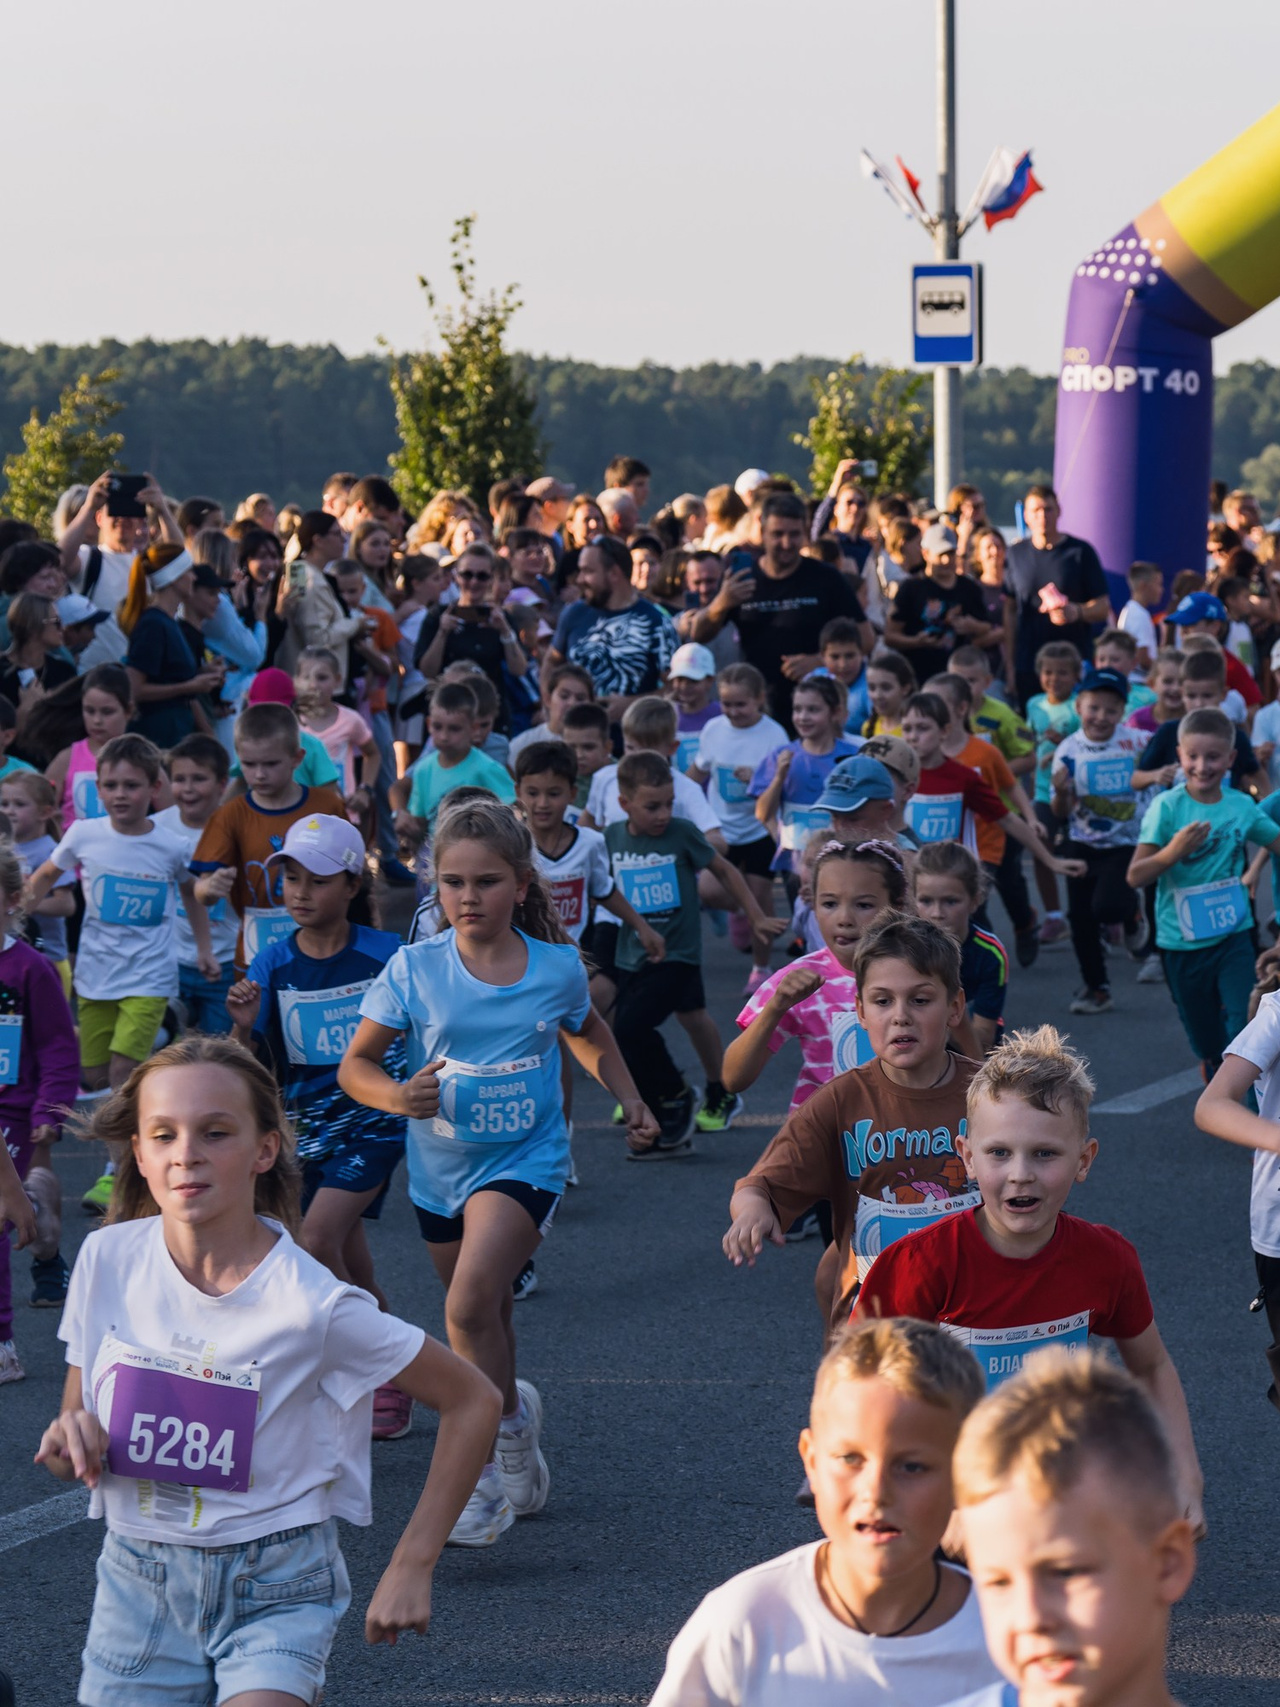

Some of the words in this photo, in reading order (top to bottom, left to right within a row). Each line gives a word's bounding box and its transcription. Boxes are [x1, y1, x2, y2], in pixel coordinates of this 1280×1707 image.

[1061, 363, 1160, 393] СПОРТ
[1164, 367, 1201, 396] 40
[118, 895, 153, 920] 724
[630, 882, 674, 908] 4198
[1208, 904, 1238, 930] 133
[478, 1082, 527, 1098] ВАРВАРА
[469, 1097, 536, 1134] 3533
[214, 1371, 231, 1382] Пэй
[127, 1413, 235, 1477] 5284
